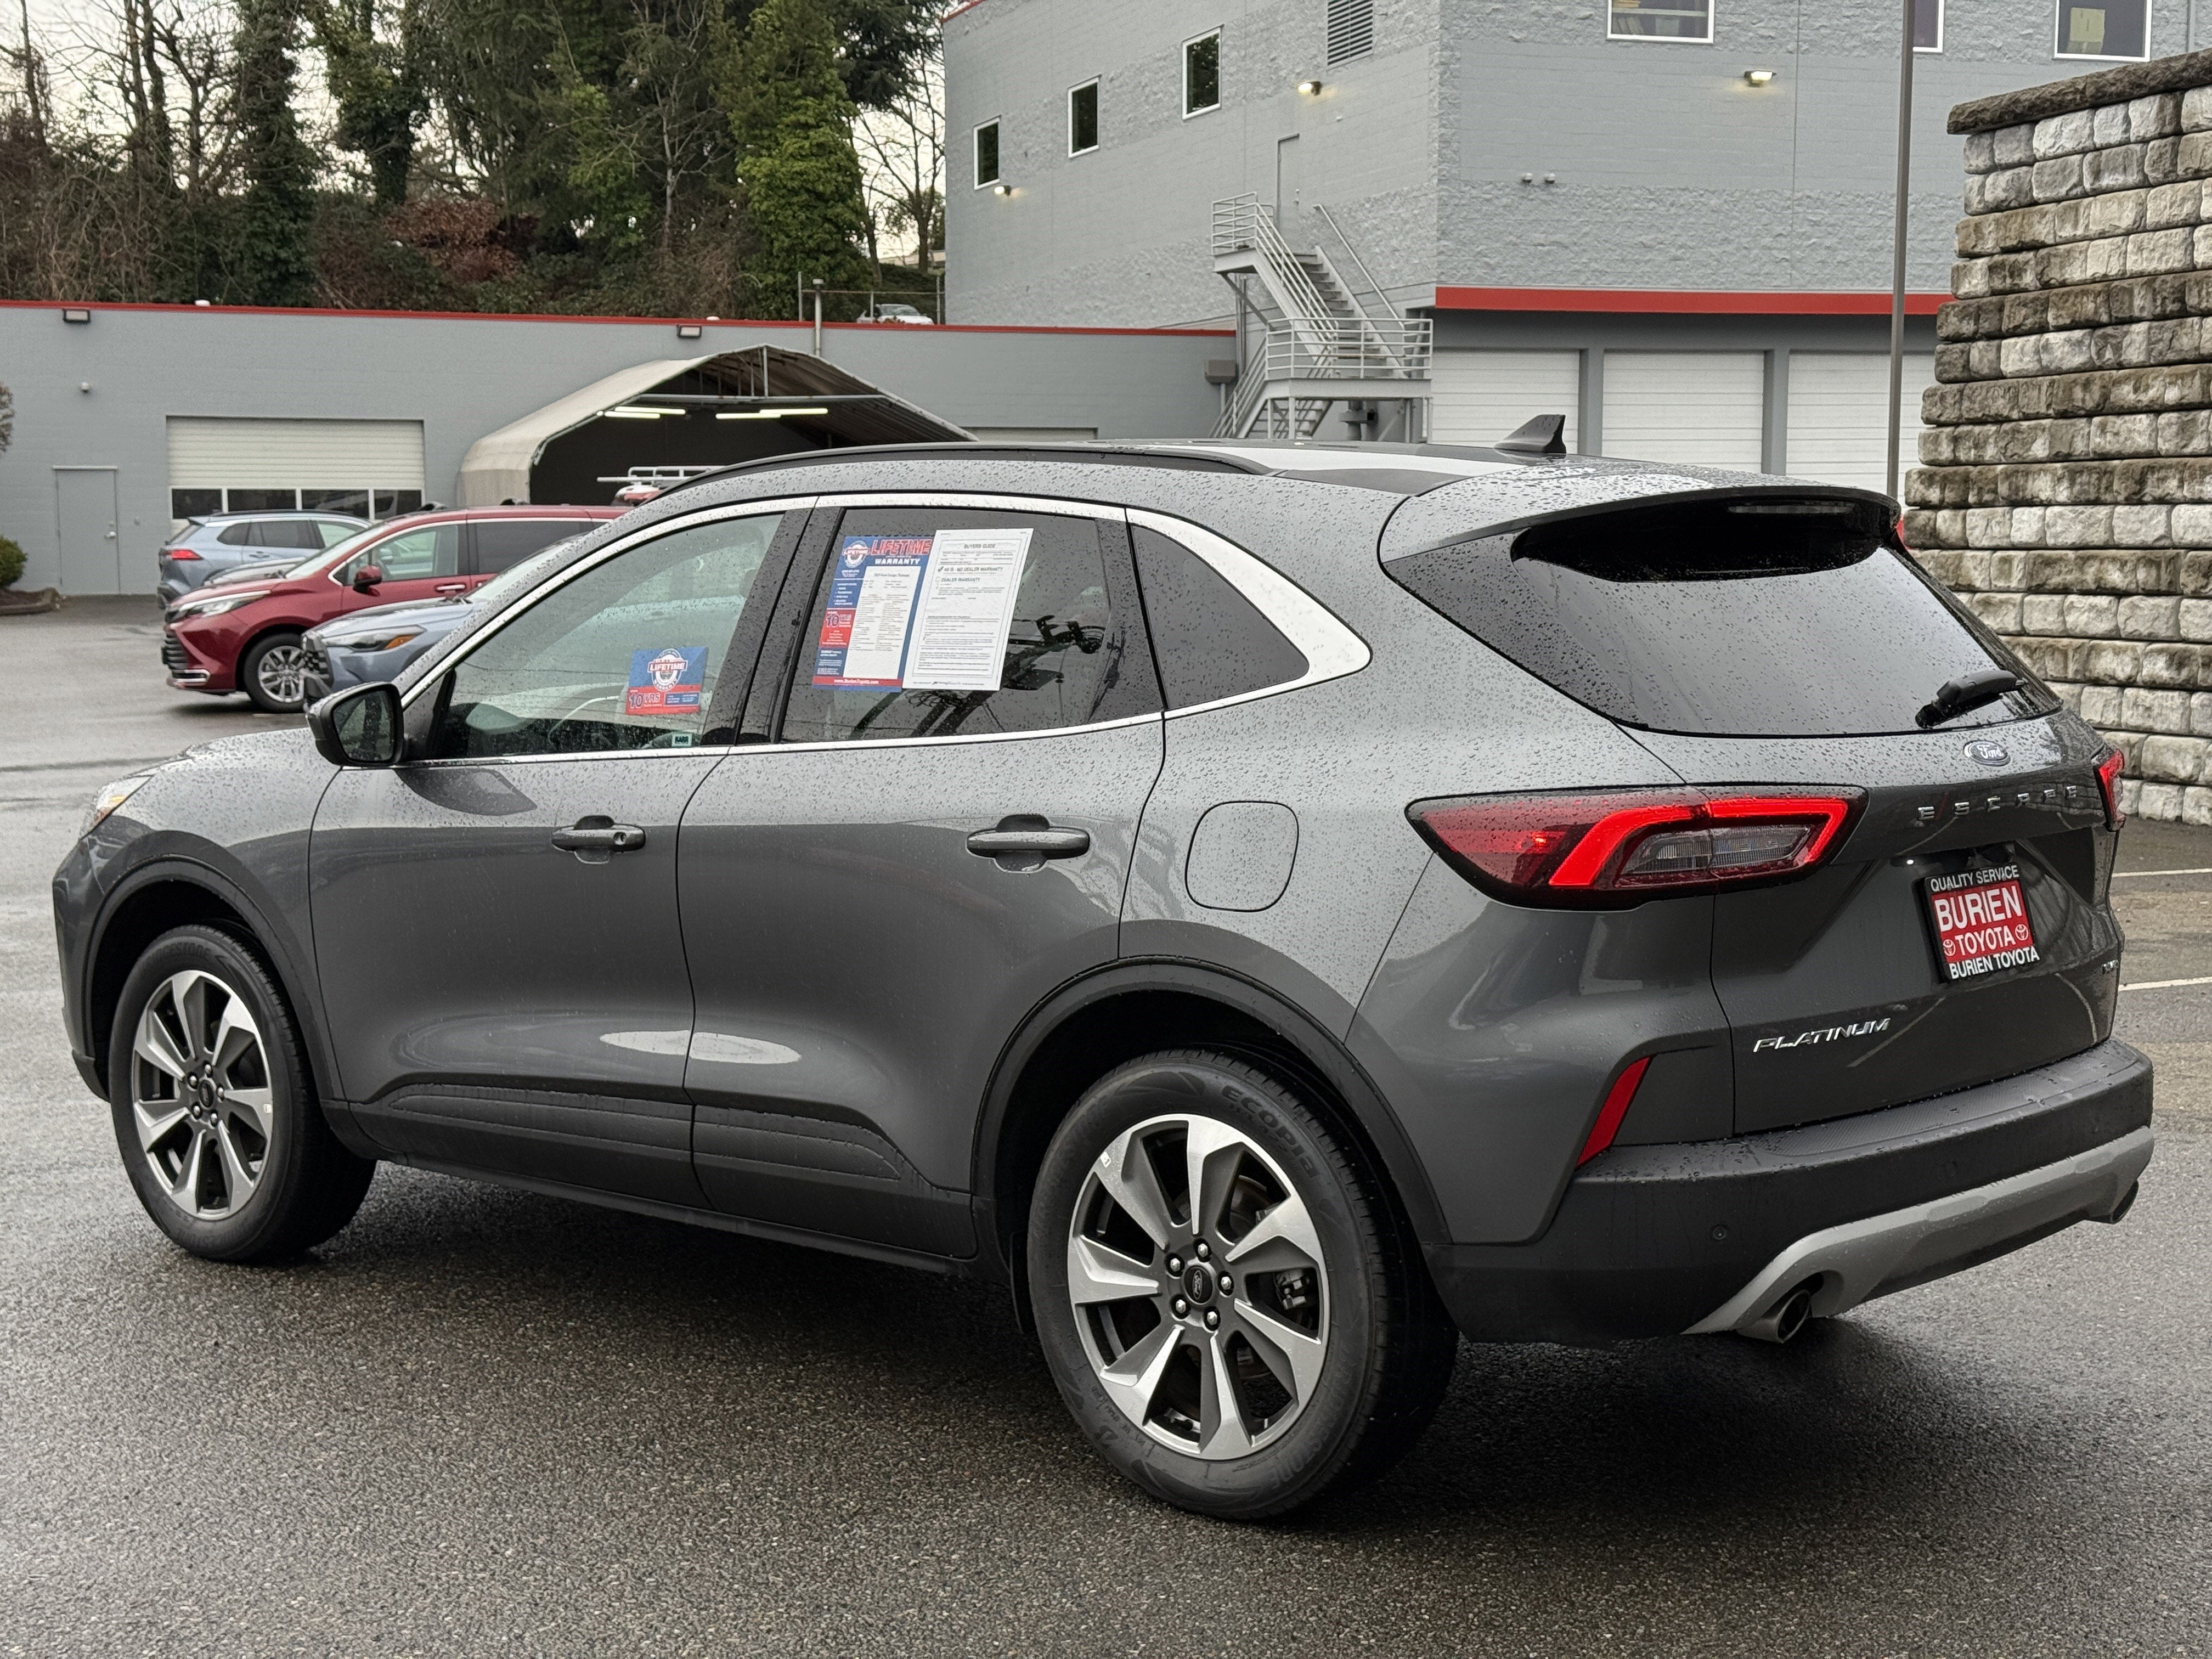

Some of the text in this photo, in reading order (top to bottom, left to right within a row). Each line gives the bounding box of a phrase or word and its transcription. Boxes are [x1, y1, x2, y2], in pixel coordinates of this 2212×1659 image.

[870, 539, 933, 556] LIFETIME
[650, 662, 685, 671] LIFETIME
[629, 693, 644, 709] 10
[1976, 743, 2005, 759] Ford
[1917, 785, 2078, 821] ESCAPE
[1930, 865, 2020, 893] QUALITY SERVICE
[1934, 885, 2023, 932] BURIEN
[1955, 925, 2016, 957] TOYOTA
[1949, 946, 2040, 980] BURIEN TOYOTA
[1753, 1017, 1891, 1053] PLATINUM
[1221, 1082, 1321, 1180] ECOPIA
